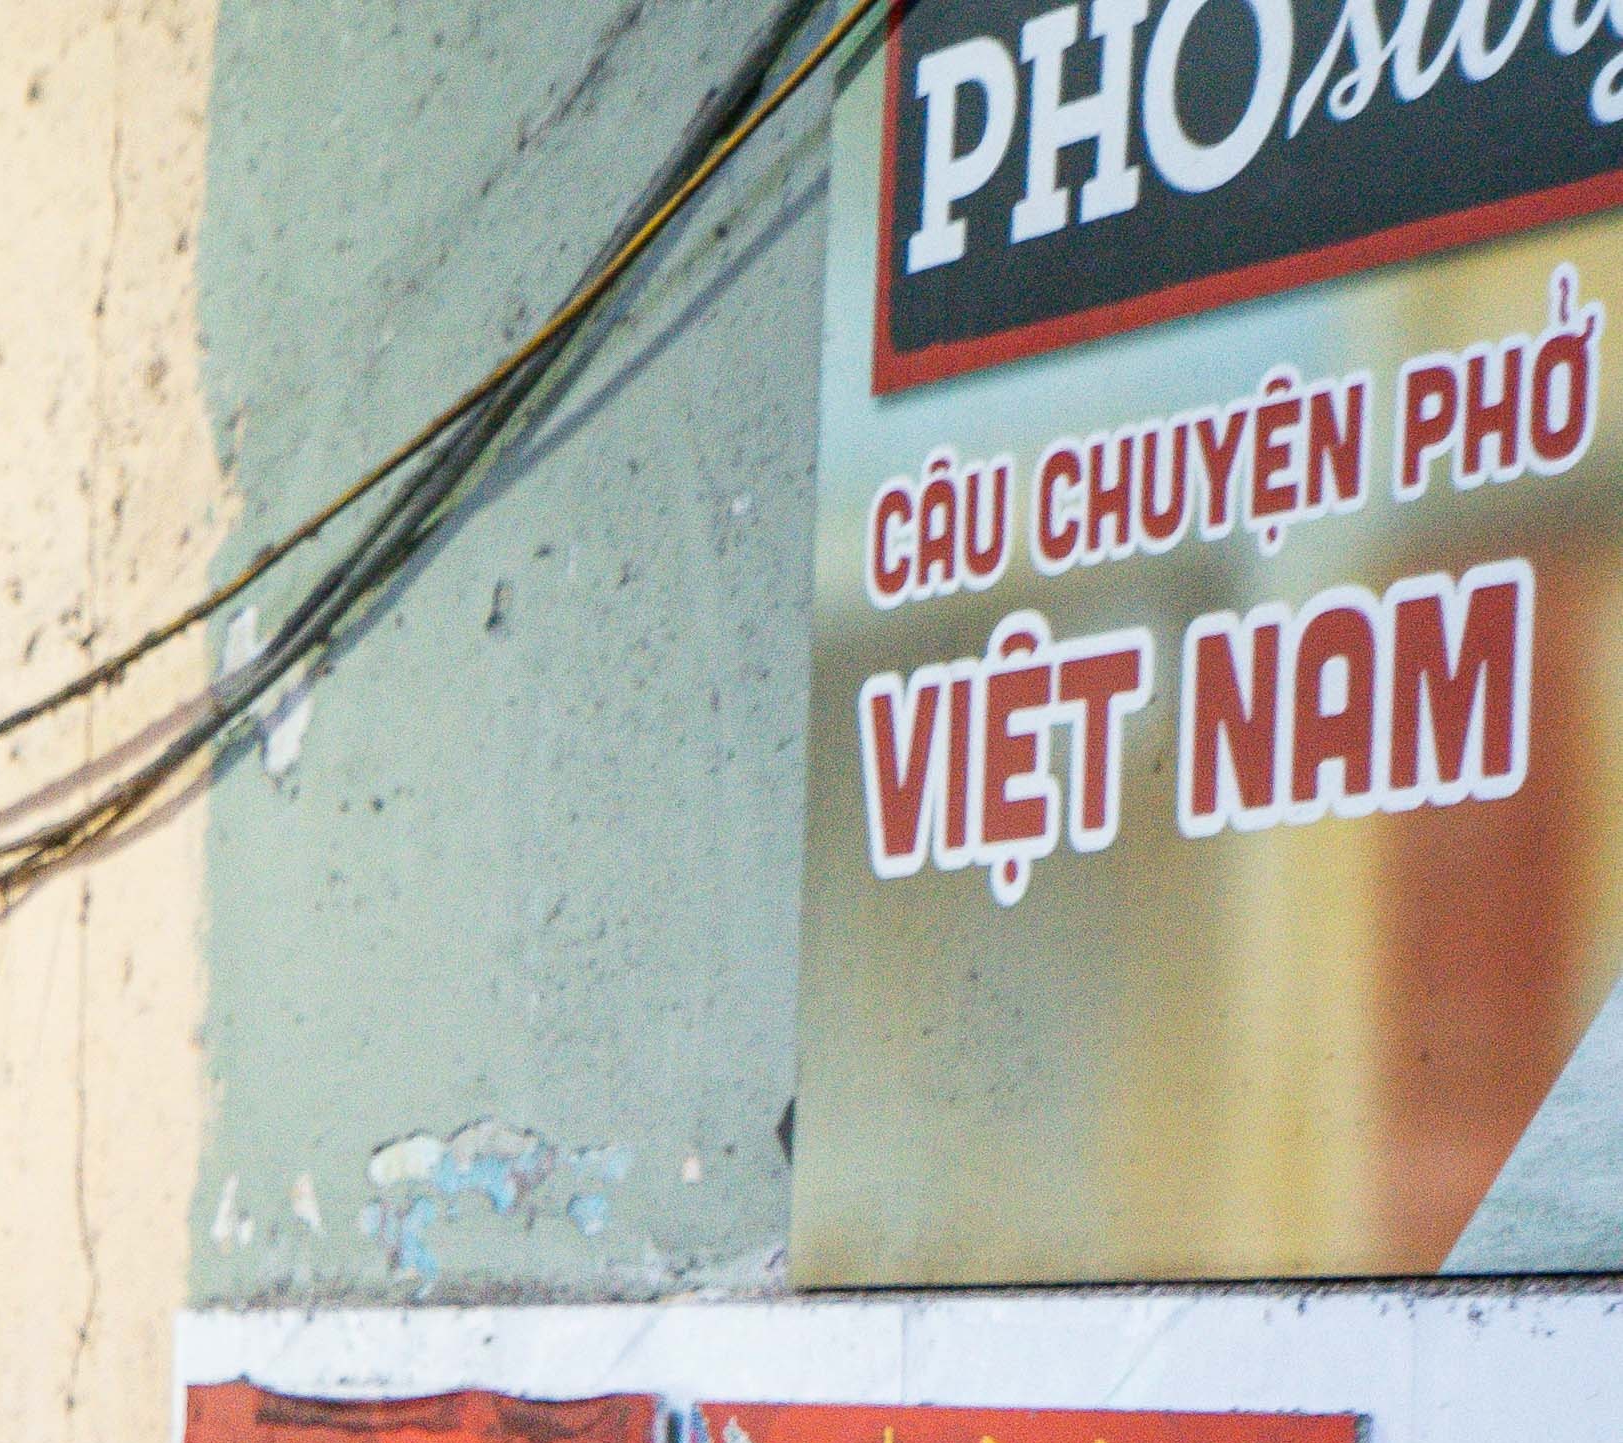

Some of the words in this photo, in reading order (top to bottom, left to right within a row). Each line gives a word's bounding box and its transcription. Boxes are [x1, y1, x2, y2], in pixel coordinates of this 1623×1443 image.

[872, 458, 1012, 600] CÂU
[1034, 373, 1367, 564] CHUYỆN
[1399, 272, 1599, 490] PHỞ
[870, 631, 1143, 888] VIỆT
[1186, 578, 1522, 818] NAM
